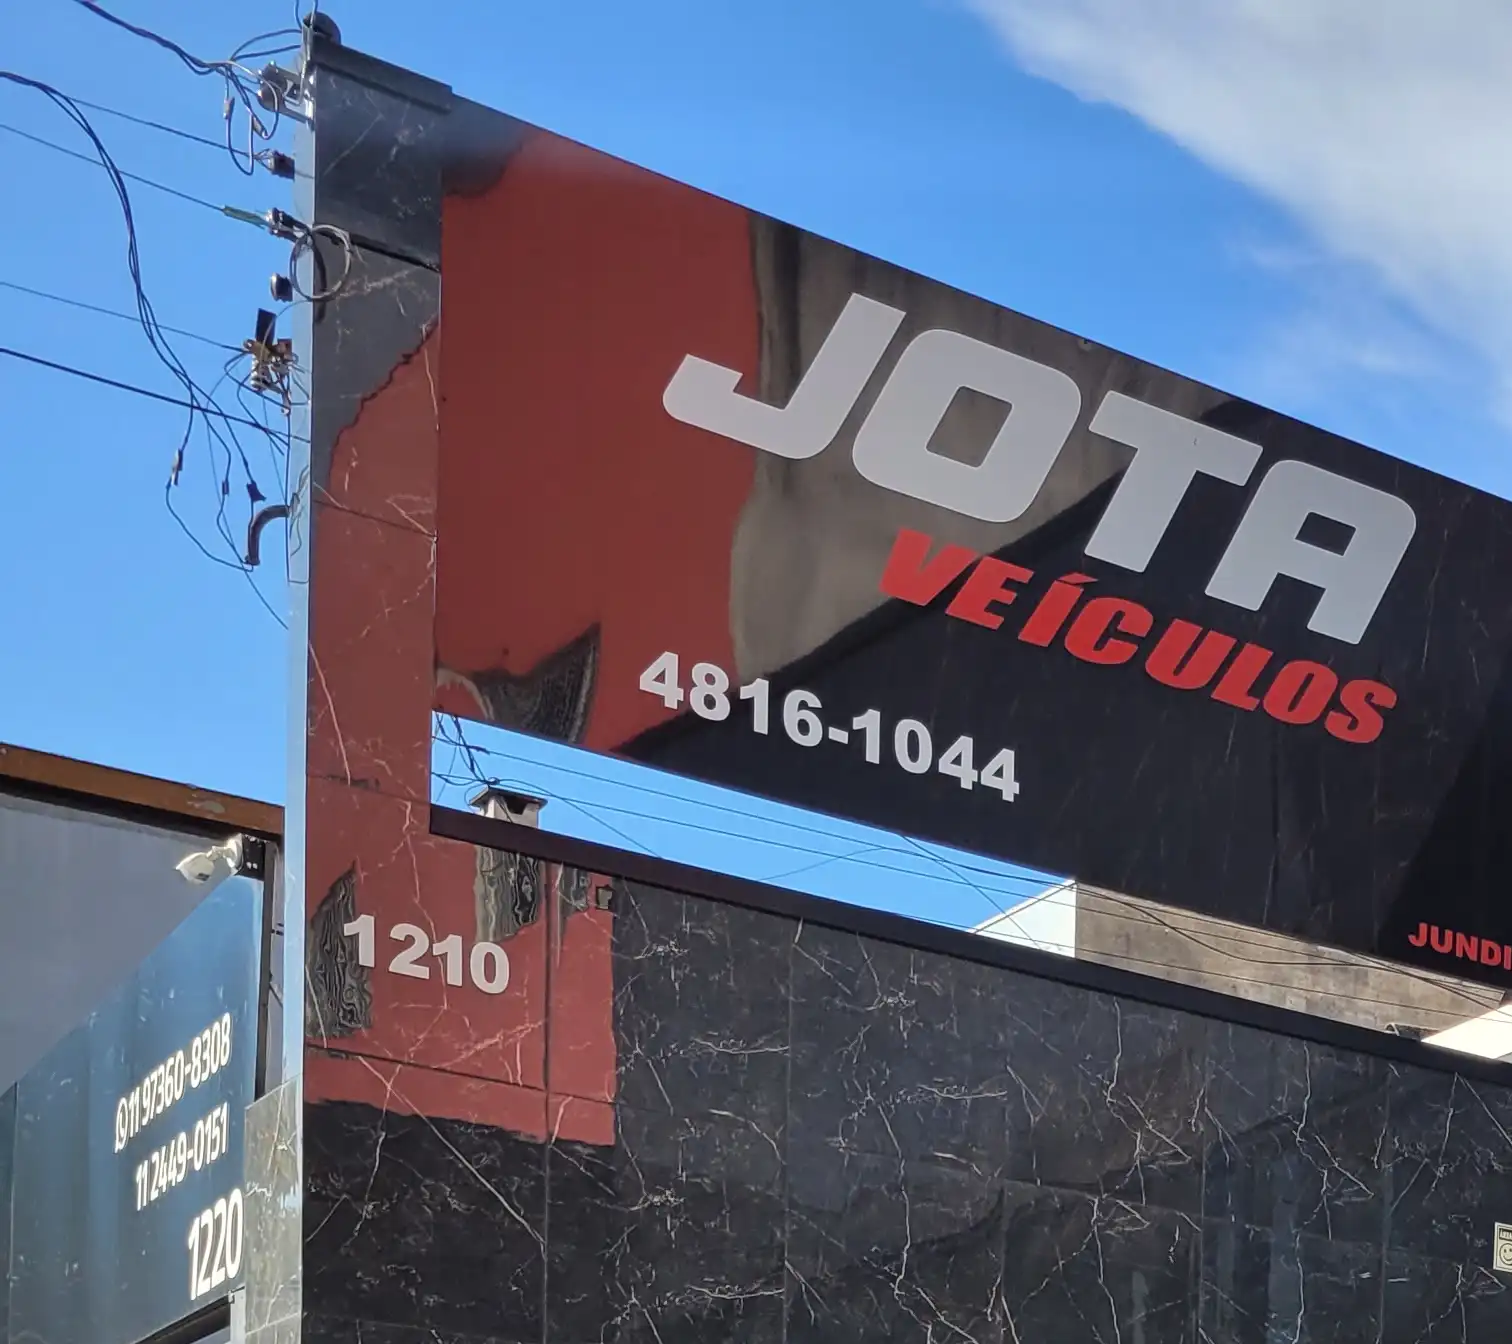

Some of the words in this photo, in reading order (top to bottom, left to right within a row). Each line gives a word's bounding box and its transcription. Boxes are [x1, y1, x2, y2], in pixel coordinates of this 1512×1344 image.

[662, 292, 1417, 645] JOTA
[878, 528, 1397, 746] VEÍCULOS
[637, 651, 1021, 803] 4816-1044
[343, 912, 512, 996] 1210
[142, 1012, 231, 1126] 97360-8308
[136, 1159, 149, 1211] 11
[150, 1101, 229, 1202] 2449-0151
[188, 1188, 244, 1300] 1220
